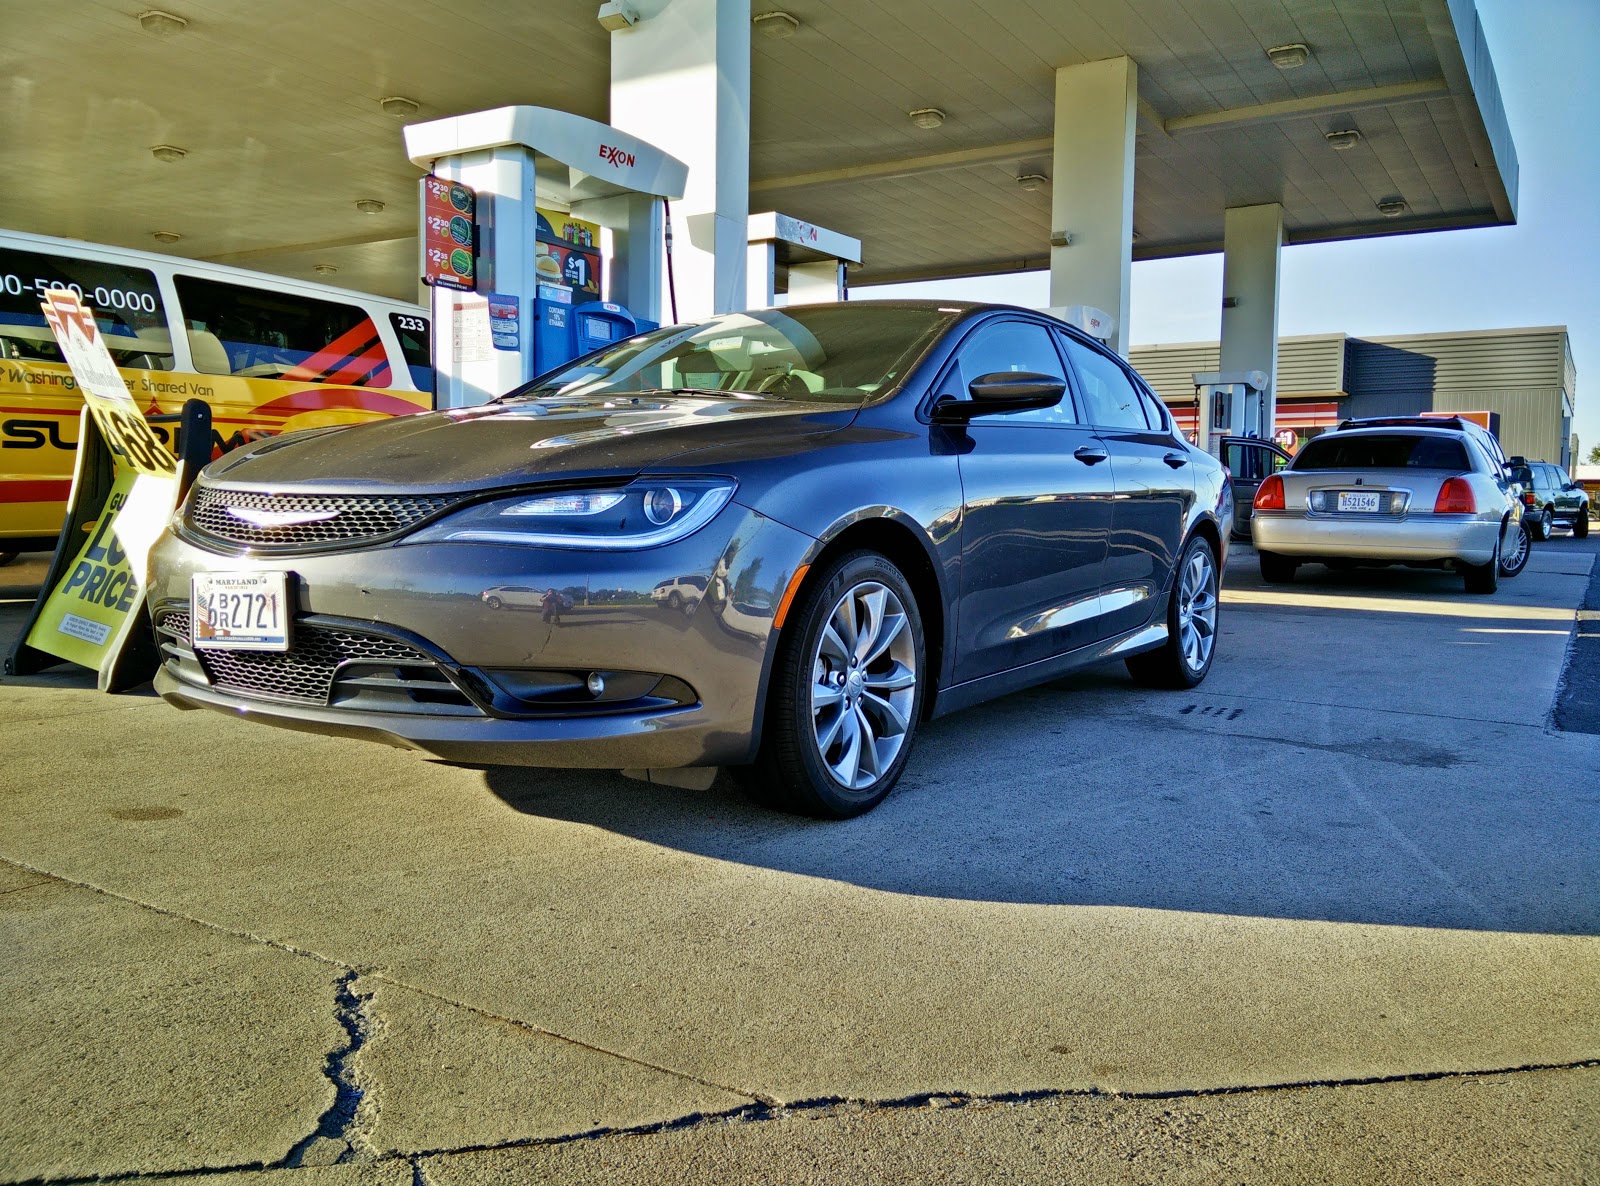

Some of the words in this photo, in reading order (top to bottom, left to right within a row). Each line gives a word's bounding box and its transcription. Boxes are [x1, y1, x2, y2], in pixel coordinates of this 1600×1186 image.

[599, 144, 635, 168] EXXON
[568, 256, 585, 286] $1
[548, 306, 566, 315] CONTAINS
[398, 316, 425, 331] 233
[548, 319, 565, 328] ETHANOL
[9, 367, 79, 390] Washing
[141, 378, 187, 395] Shared
[189, 382, 214, 397] Van
[1342, 497, 1376, 507] H521546
[62, 561, 139, 612] PRICE
